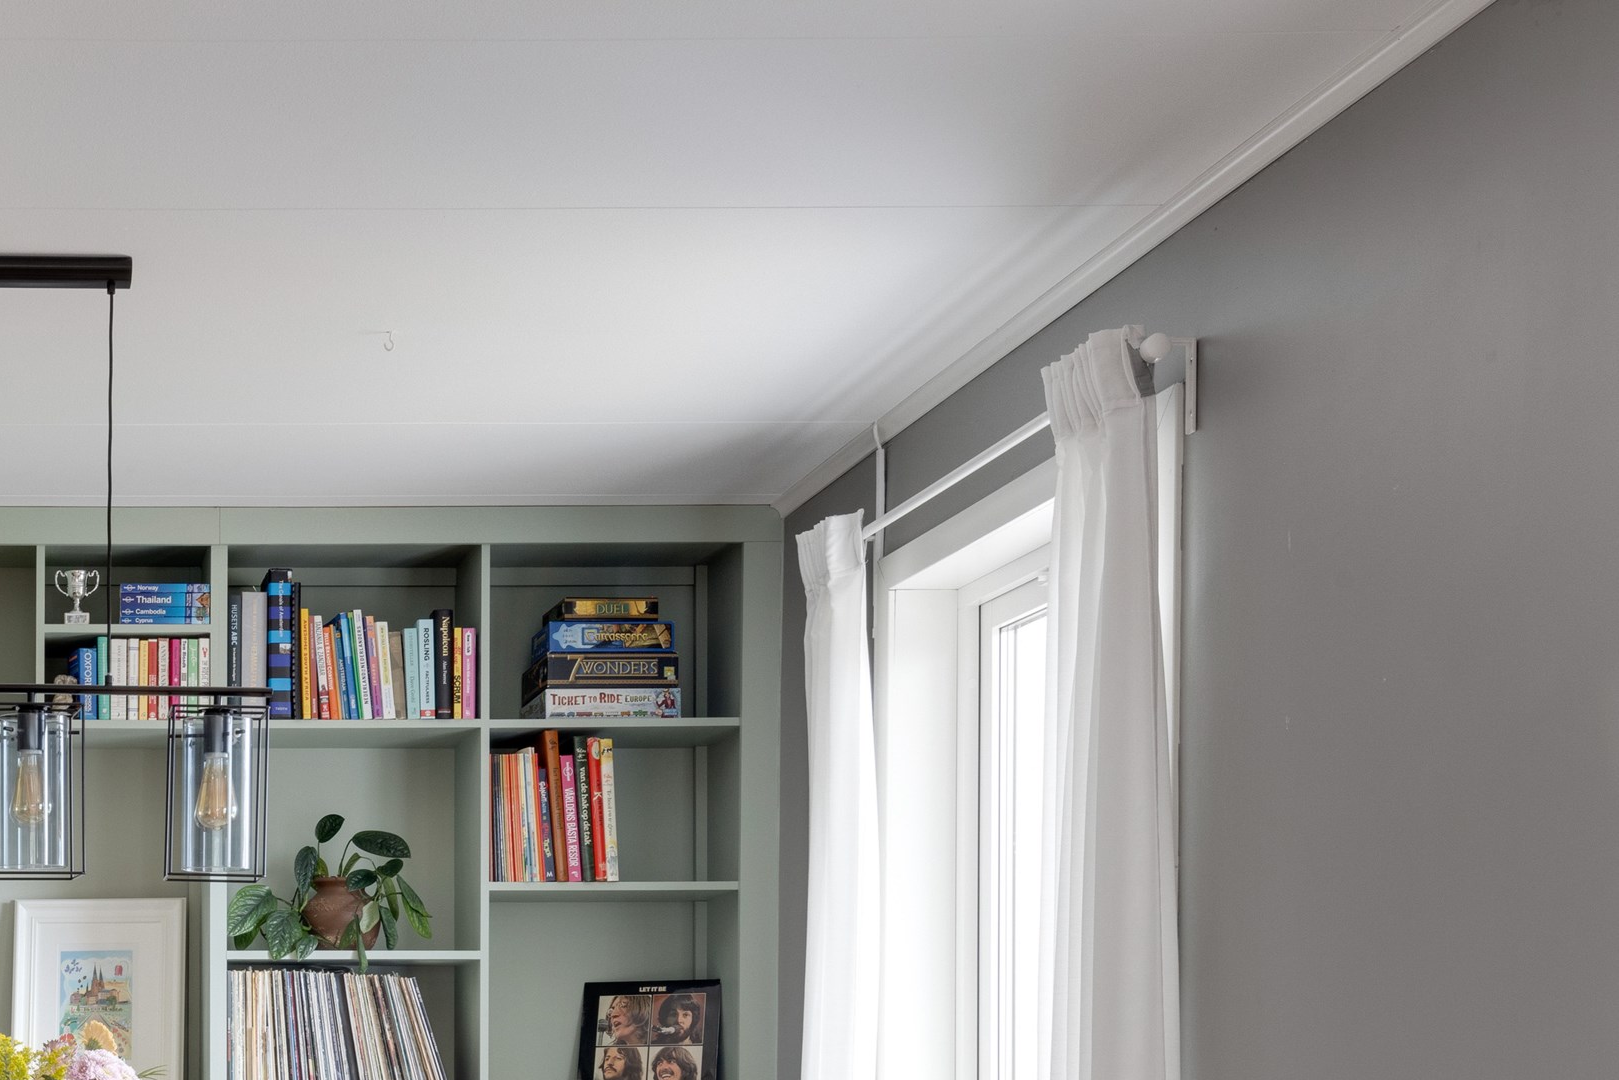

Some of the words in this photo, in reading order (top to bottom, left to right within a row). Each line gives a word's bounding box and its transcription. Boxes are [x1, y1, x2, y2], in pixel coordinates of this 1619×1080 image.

[596, 603, 629, 614] DUEL
[440, 616, 450, 656] Napoleon
[585, 631, 648, 642] Carcassonne
[356, 626, 365, 669] NEDERLANDERS
[567, 655, 584, 681] 7
[581, 661, 658, 674] WONDERS
[550, 693, 587, 706] TICKET
[599, 692, 622, 704] RIDE
[625, 694, 652, 702] EUROPE
[581, 783, 588, 793] de
[565, 787, 575, 822] VÄRLDENS
[581, 794, 589, 809] hak
[581, 809, 589, 819] op
[583, 821, 592, 831] de
[566, 823, 577, 844] BÄSTA
[583, 831, 592, 845] tak
[568, 845, 578, 867] RESOR
